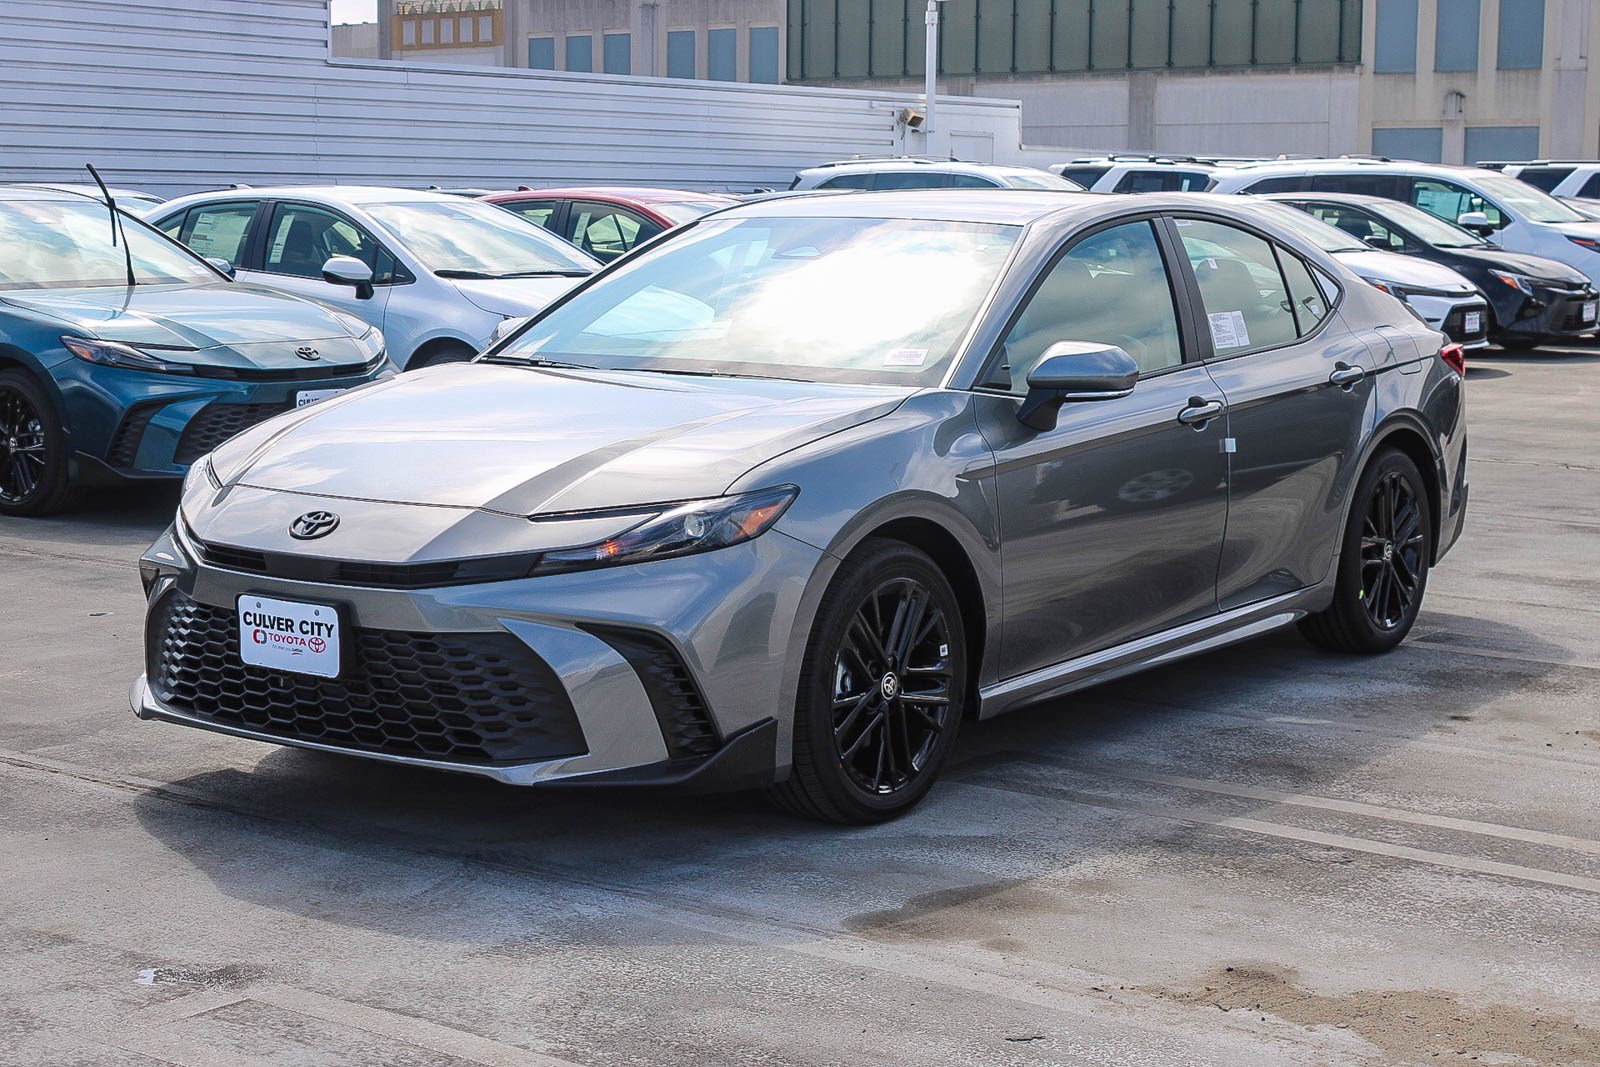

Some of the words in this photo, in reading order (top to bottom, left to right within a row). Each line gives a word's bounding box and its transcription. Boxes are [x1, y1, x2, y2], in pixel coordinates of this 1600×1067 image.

[243, 611, 294, 632] CULVER
[299, 620, 334, 638] CITY
[268, 632, 307, 646] TOYOTA
